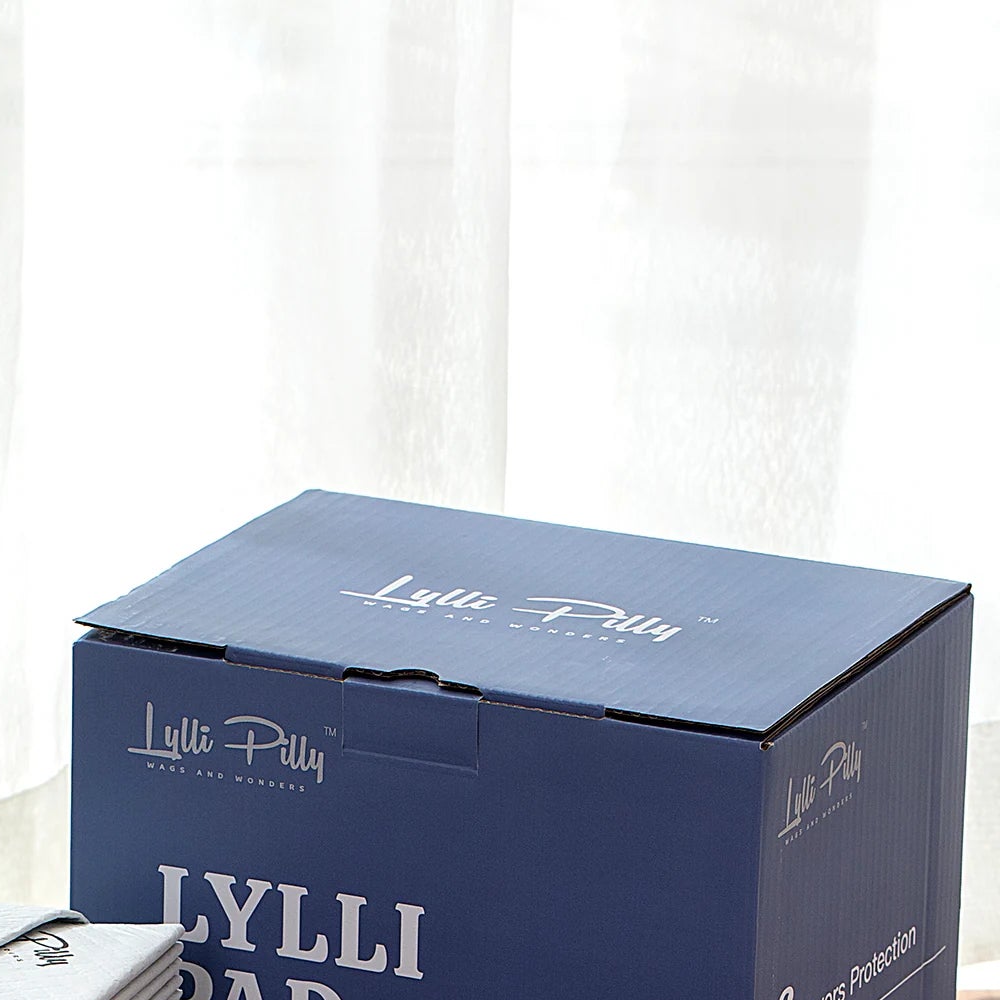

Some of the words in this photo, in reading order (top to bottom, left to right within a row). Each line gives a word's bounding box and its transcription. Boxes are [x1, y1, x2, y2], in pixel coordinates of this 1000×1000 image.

[339, 575, 498, 608] Lylli
[512, 597, 682, 642] Pilly
[363, 600, 427, 614] WAGS
[444, 614, 490, 624] AND
[509, 623, 626, 643] WONDERS
[128, 702, 213, 760] Lylli
[224, 716, 324, 783] Pilly
[146, 761, 185, 774] WAGS
[196, 769, 224, 779] AND
[235, 775, 305, 792] WONDERS
[778, 773, 817, 838] Lylli
[819, 741, 862, 796] Pilly
[158, 864, 425, 980] LYLLI
[850, 926, 916, 995] Protection
